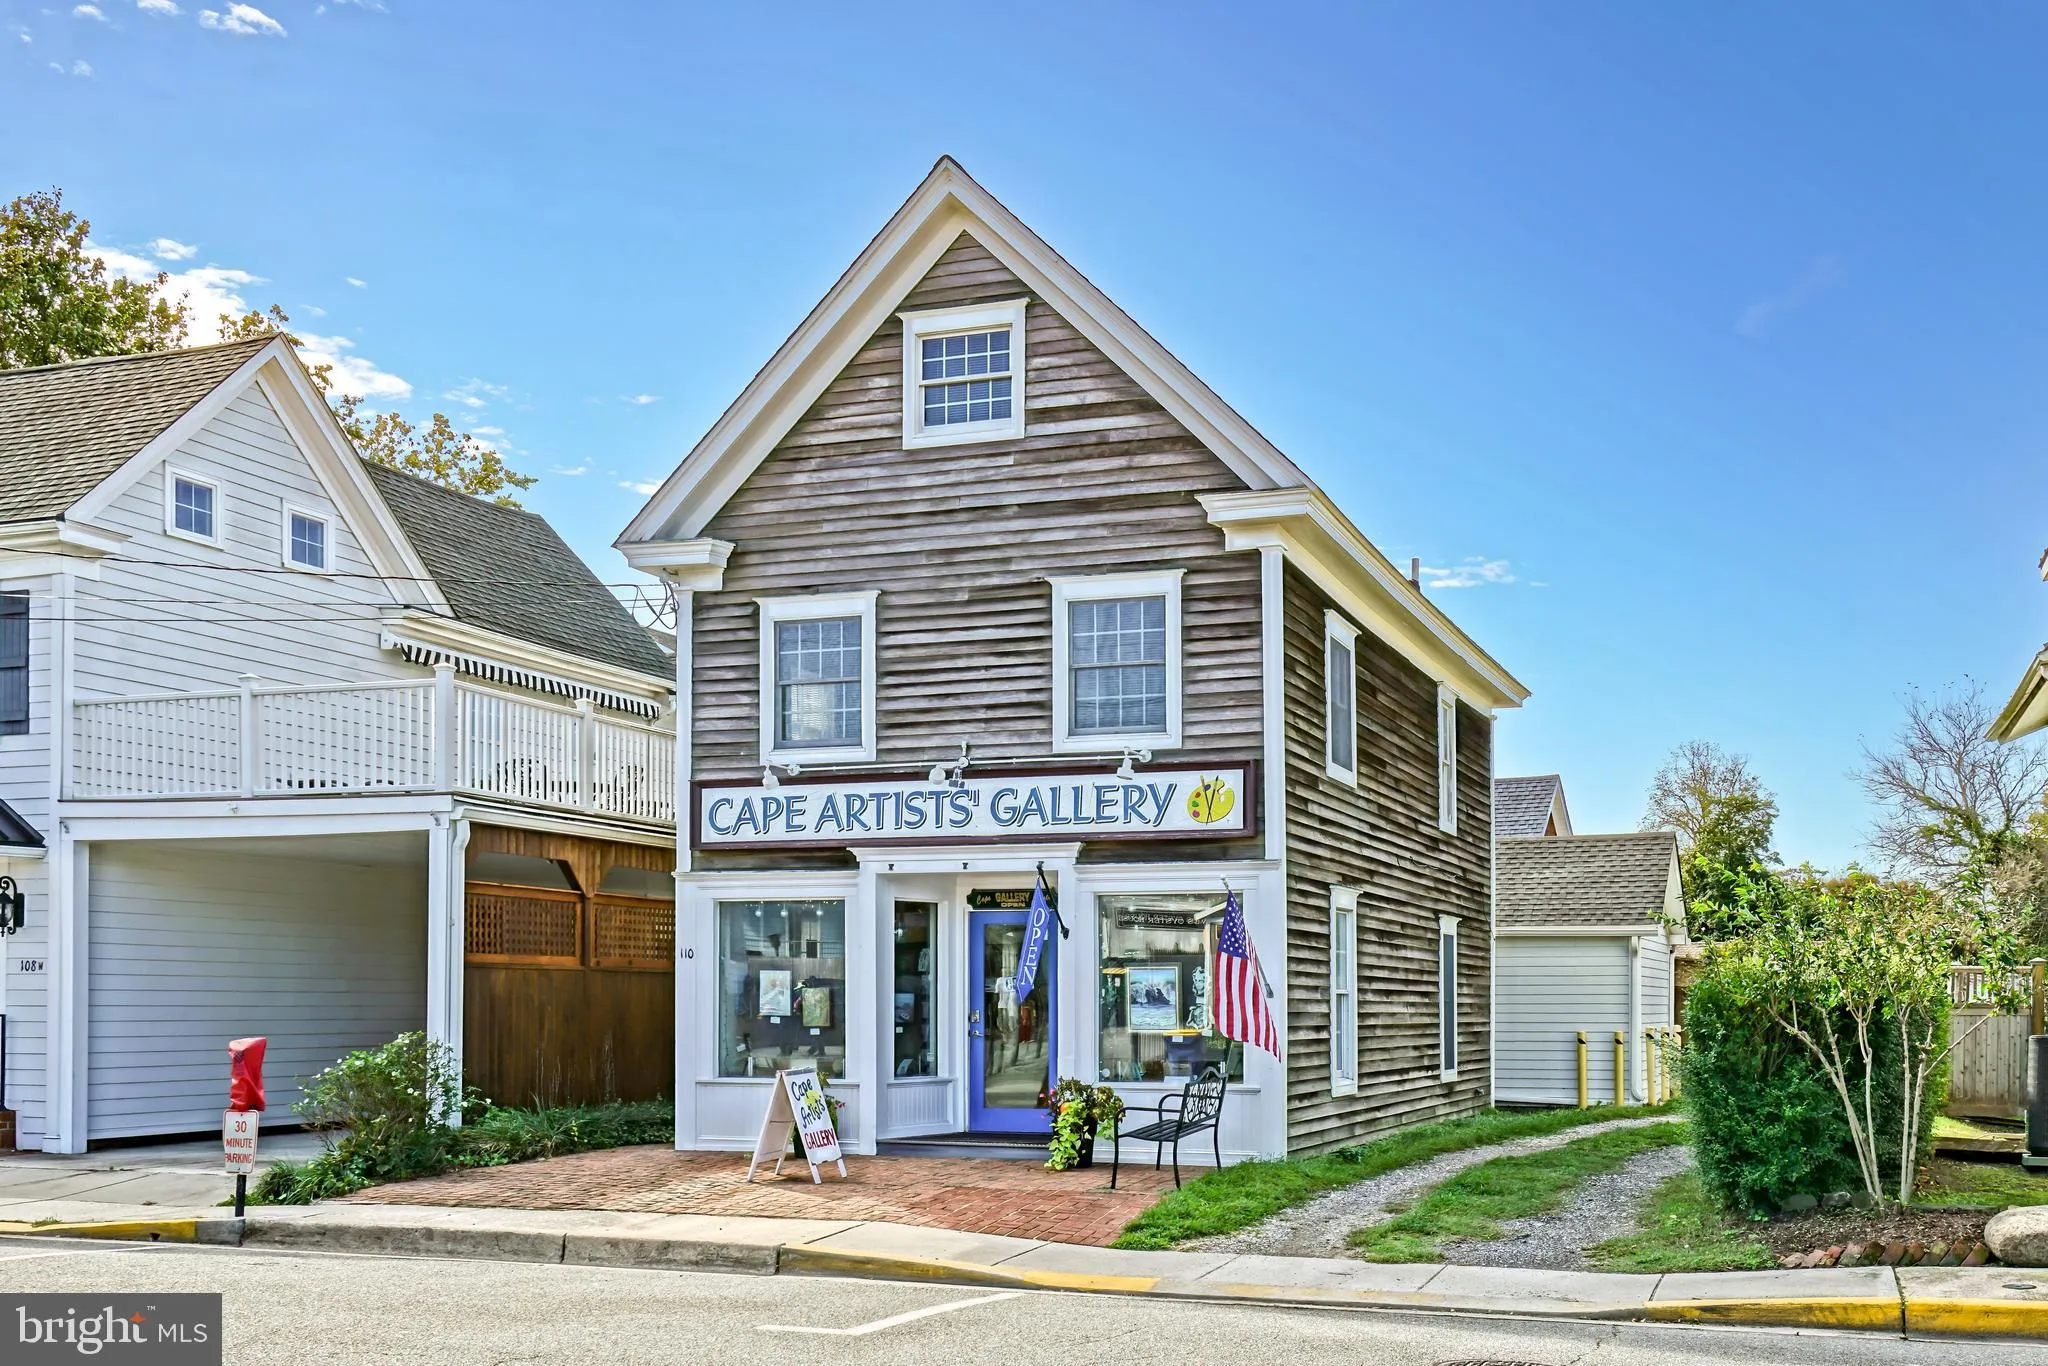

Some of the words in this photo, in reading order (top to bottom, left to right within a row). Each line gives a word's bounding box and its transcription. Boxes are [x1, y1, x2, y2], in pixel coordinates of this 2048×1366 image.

[708, 795, 808, 835] CAPE
[813, 789, 980, 834] ARTISTS'
[989, 782, 1177, 828] GALLERY
[995, 892, 1030, 902] GALLERY
[1020, 907, 1046, 986] OPEN
[680, 948, 694, 959] 110
[20, 960, 37, 972] 108
[791, 1078, 813, 1102] Cape
[235, 1121, 247, 1132] 30
[225, 1138, 253, 1148] MINUTE
[804, 1128, 836, 1149] GALLERY
[224, 1153, 253, 1164] PARKING
